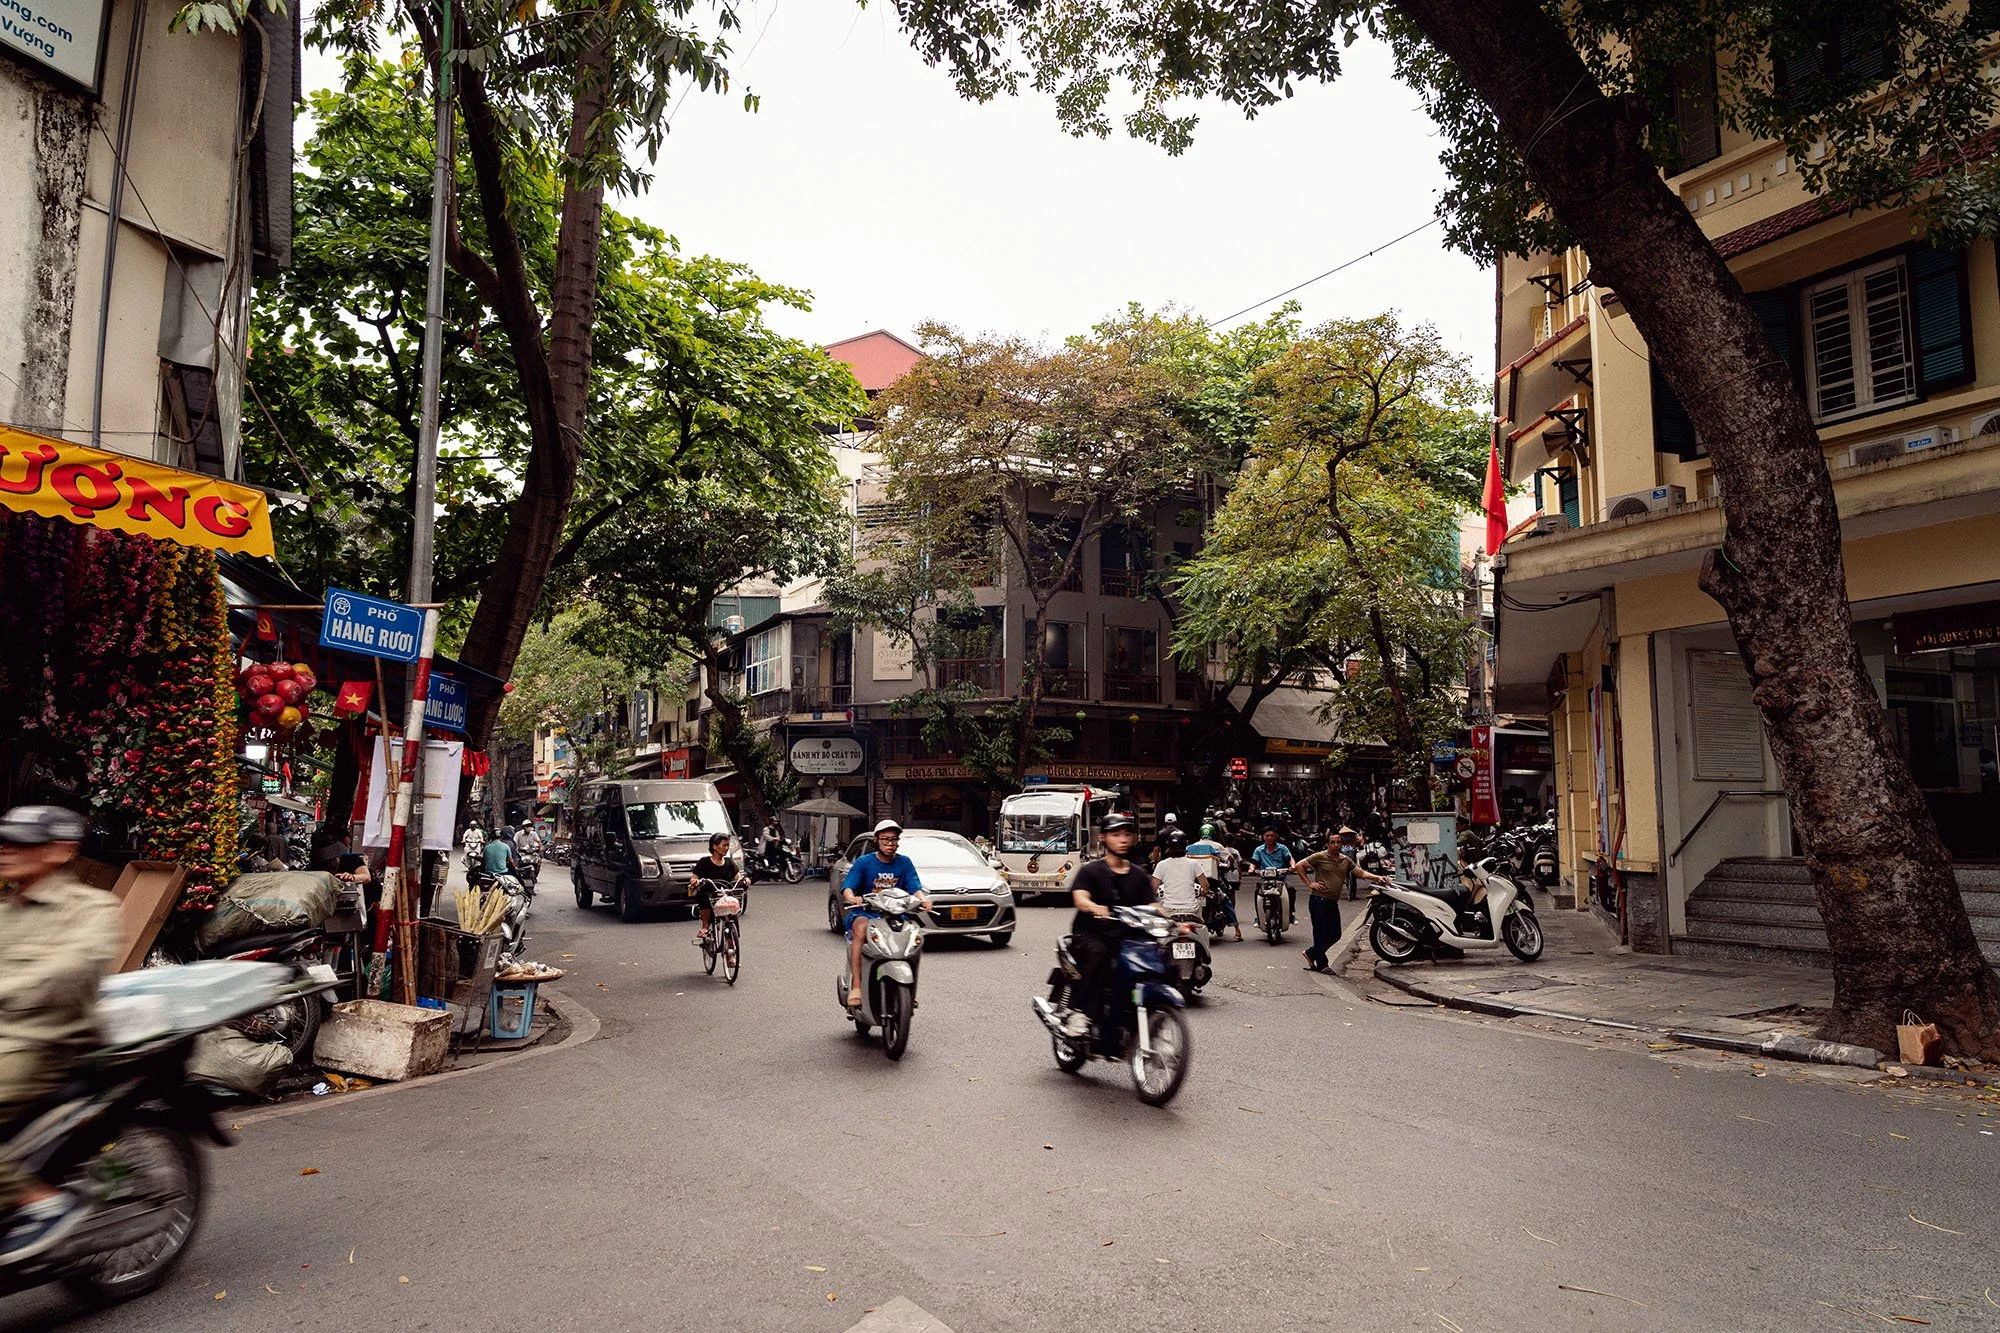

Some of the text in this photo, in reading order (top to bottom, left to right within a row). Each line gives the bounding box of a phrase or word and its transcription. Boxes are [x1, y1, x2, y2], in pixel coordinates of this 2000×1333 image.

[2, 16, 55, 58] Vượng
[368, 606, 399, 622] PHỐ
[331, 617, 413, 653] HÀNG RƯƠI
[439, 683, 456, 695] PHỐ
[424, 693, 464, 727] ÀNG LƯỢC
[1048, 763, 1075, 776] black
[1088, 765, 1118, 777] brown
[1119, 768, 1144, 779] coffee
